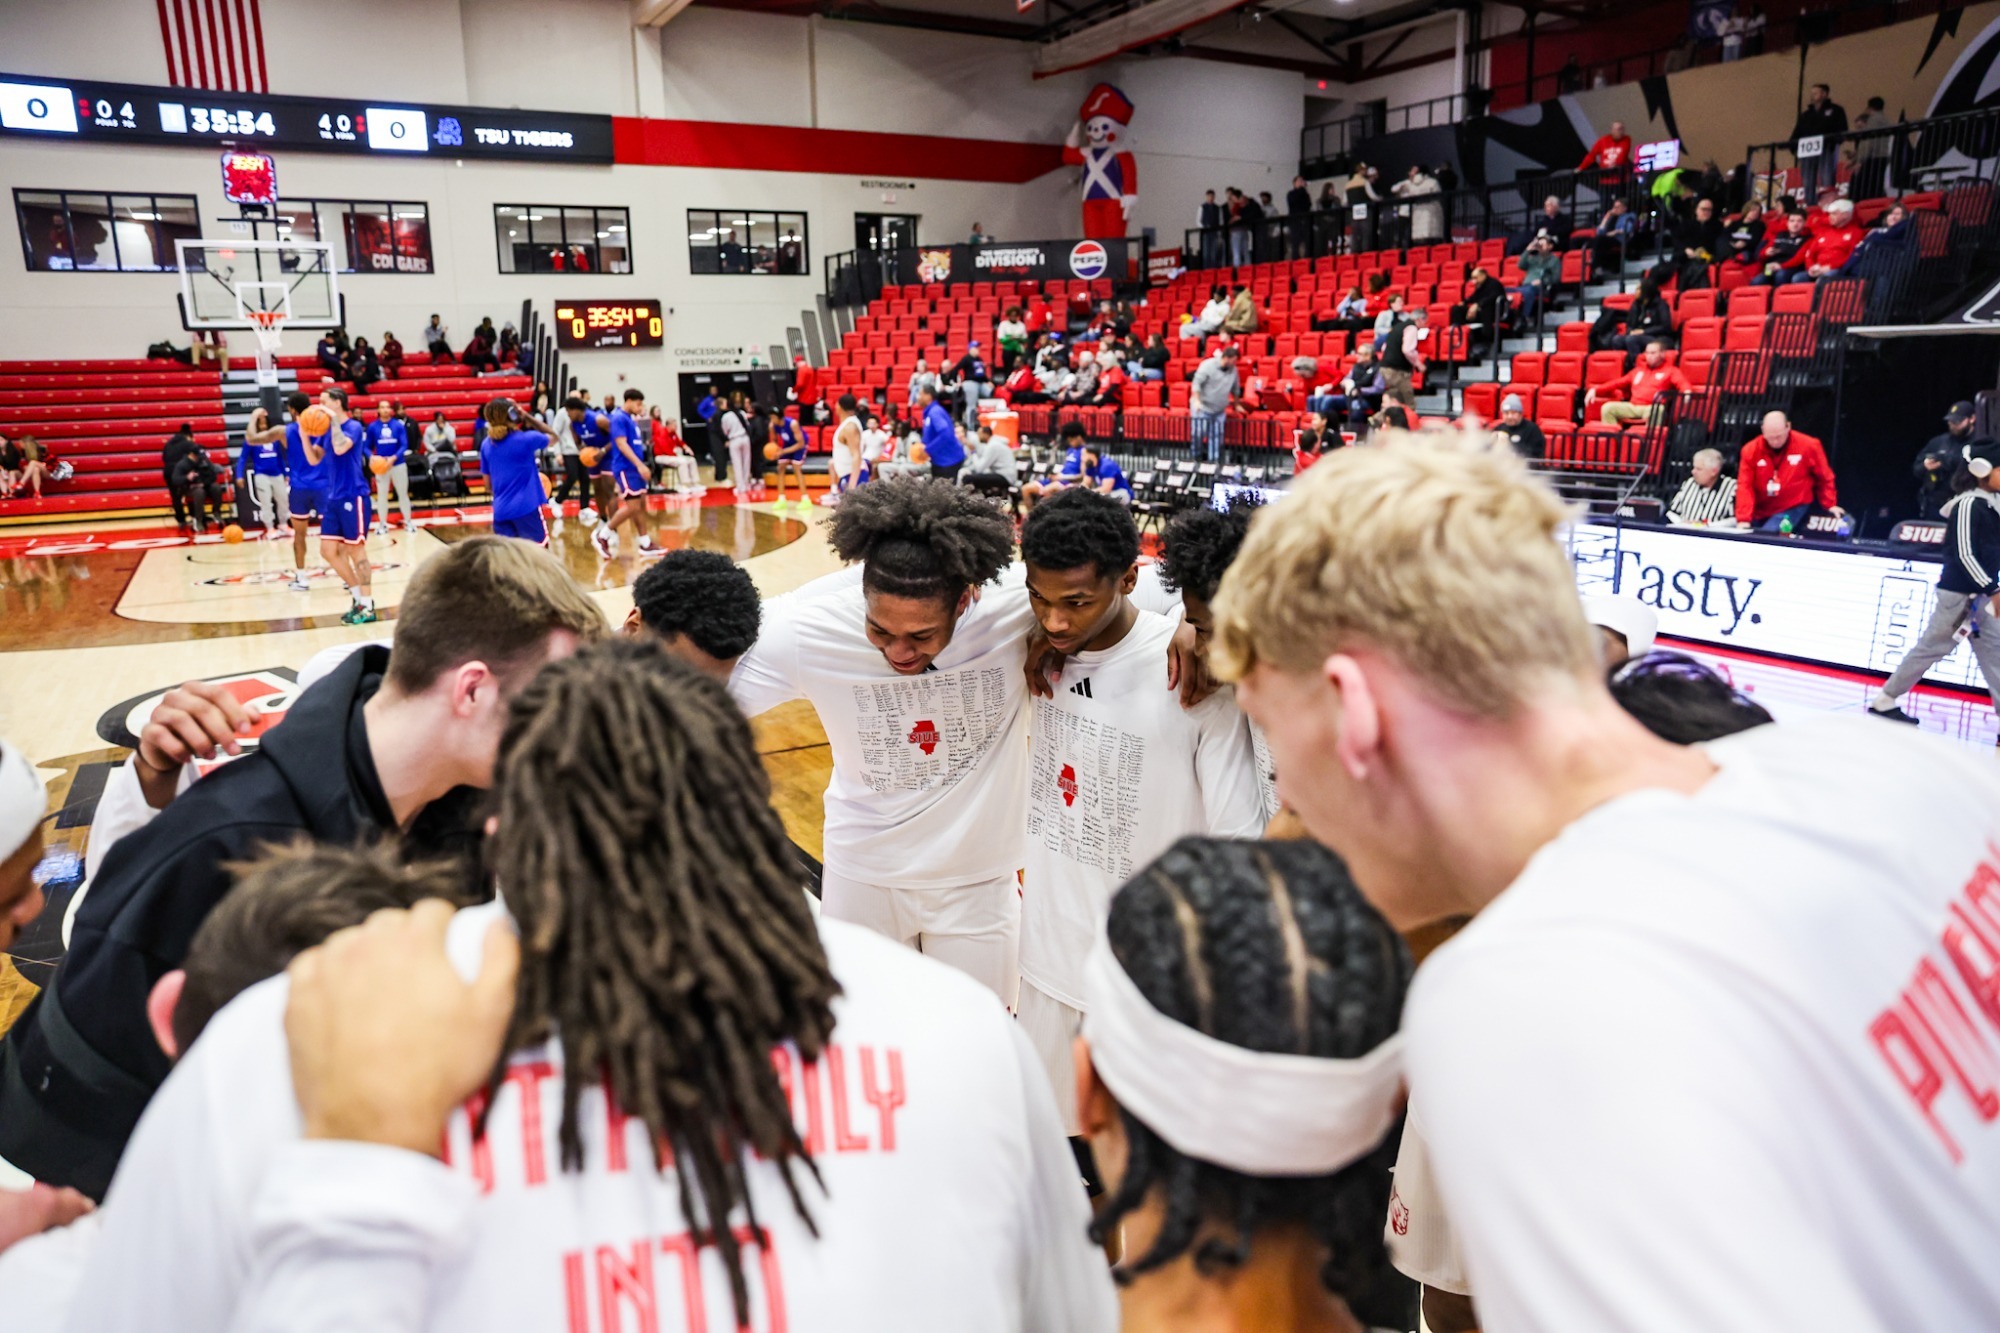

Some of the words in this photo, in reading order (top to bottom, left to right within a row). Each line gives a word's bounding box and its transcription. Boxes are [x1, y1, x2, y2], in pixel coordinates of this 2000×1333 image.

[27, 98, 48, 118] 0
[96, 99, 113, 119] 0
[119, 101, 136, 120] 4
[190, 107, 276, 136] 35:54
[318, 113, 332, 131] 4
[336, 114, 351, 132] 0
[390, 121, 406, 139] 0
[474, 127, 510, 145] TSU
[511, 130, 574, 149] TIGERS
[1799, 139, 1822, 154] 103
[861, 180, 908, 190] RESTROOMS
[975, 253, 1038, 268] DIVISION
[1073, 256, 1104, 264] PEPSI
[587, 307, 633, 327] 35:54
[649, 317, 663, 337] 0
[572, 318, 586, 339] 0
[674, 347, 737, 356] CONCESSIONS
[680, 358, 732, 367] RESTROOMS
[1900, 524, 1947, 544] SIUE
[1603, 548, 1762, 635] Tasty.
[907, 731, 941, 744] SIUE
[1057, 774, 1079, 798] SIUE
